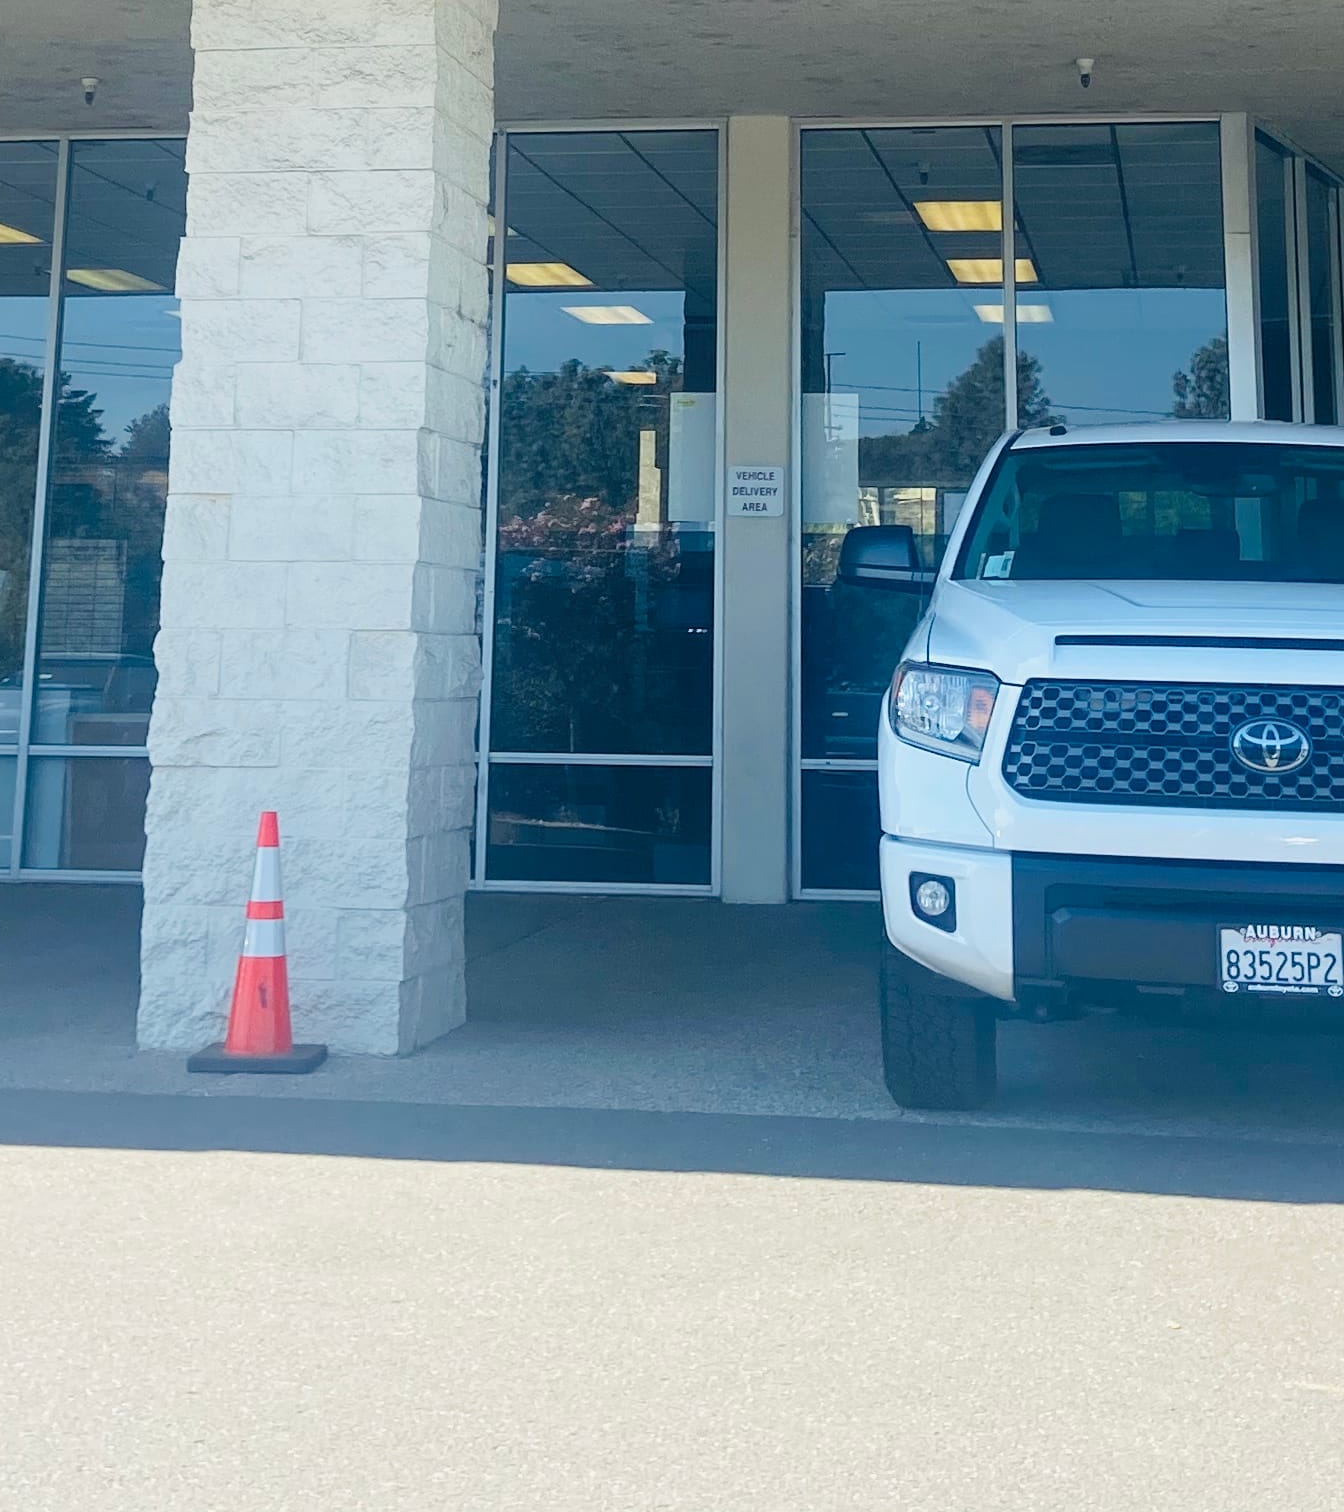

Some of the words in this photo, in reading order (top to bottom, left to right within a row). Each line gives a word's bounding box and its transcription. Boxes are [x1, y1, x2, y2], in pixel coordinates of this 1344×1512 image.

[735, 471, 775, 481] VEHICLE
[732, 486, 778, 496] DELIVERY
[742, 502, 768, 512] AREA
[1245, 925, 1316, 940] AUBURN
[1227, 949, 1338, 984] 83525P2
